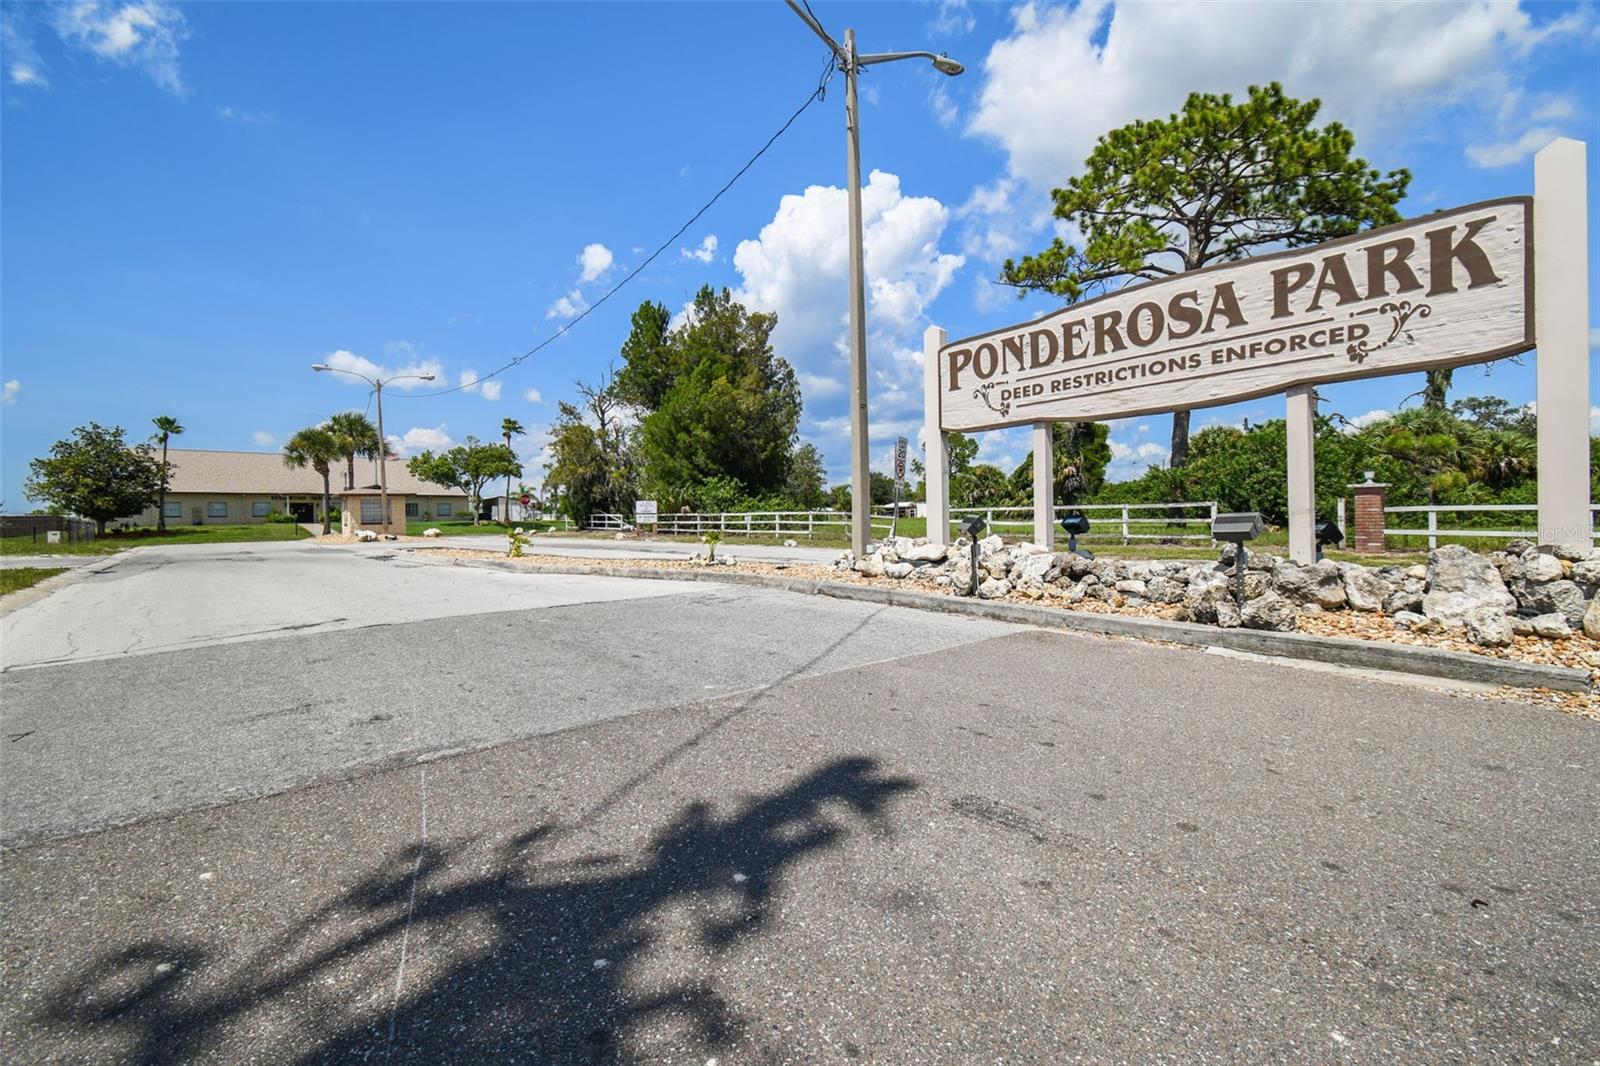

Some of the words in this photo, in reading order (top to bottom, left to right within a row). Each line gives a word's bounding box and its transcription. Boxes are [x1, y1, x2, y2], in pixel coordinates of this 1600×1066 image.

[948, 281, 1248, 392] PONDEROSA
[1270, 216, 1502, 320] PARK
[1001, 383, 1044, 401] DEED
[1050, 353, 1202, 393] RESTRICTIONS
[1211, 323, 1370, 365] ENFORCED
